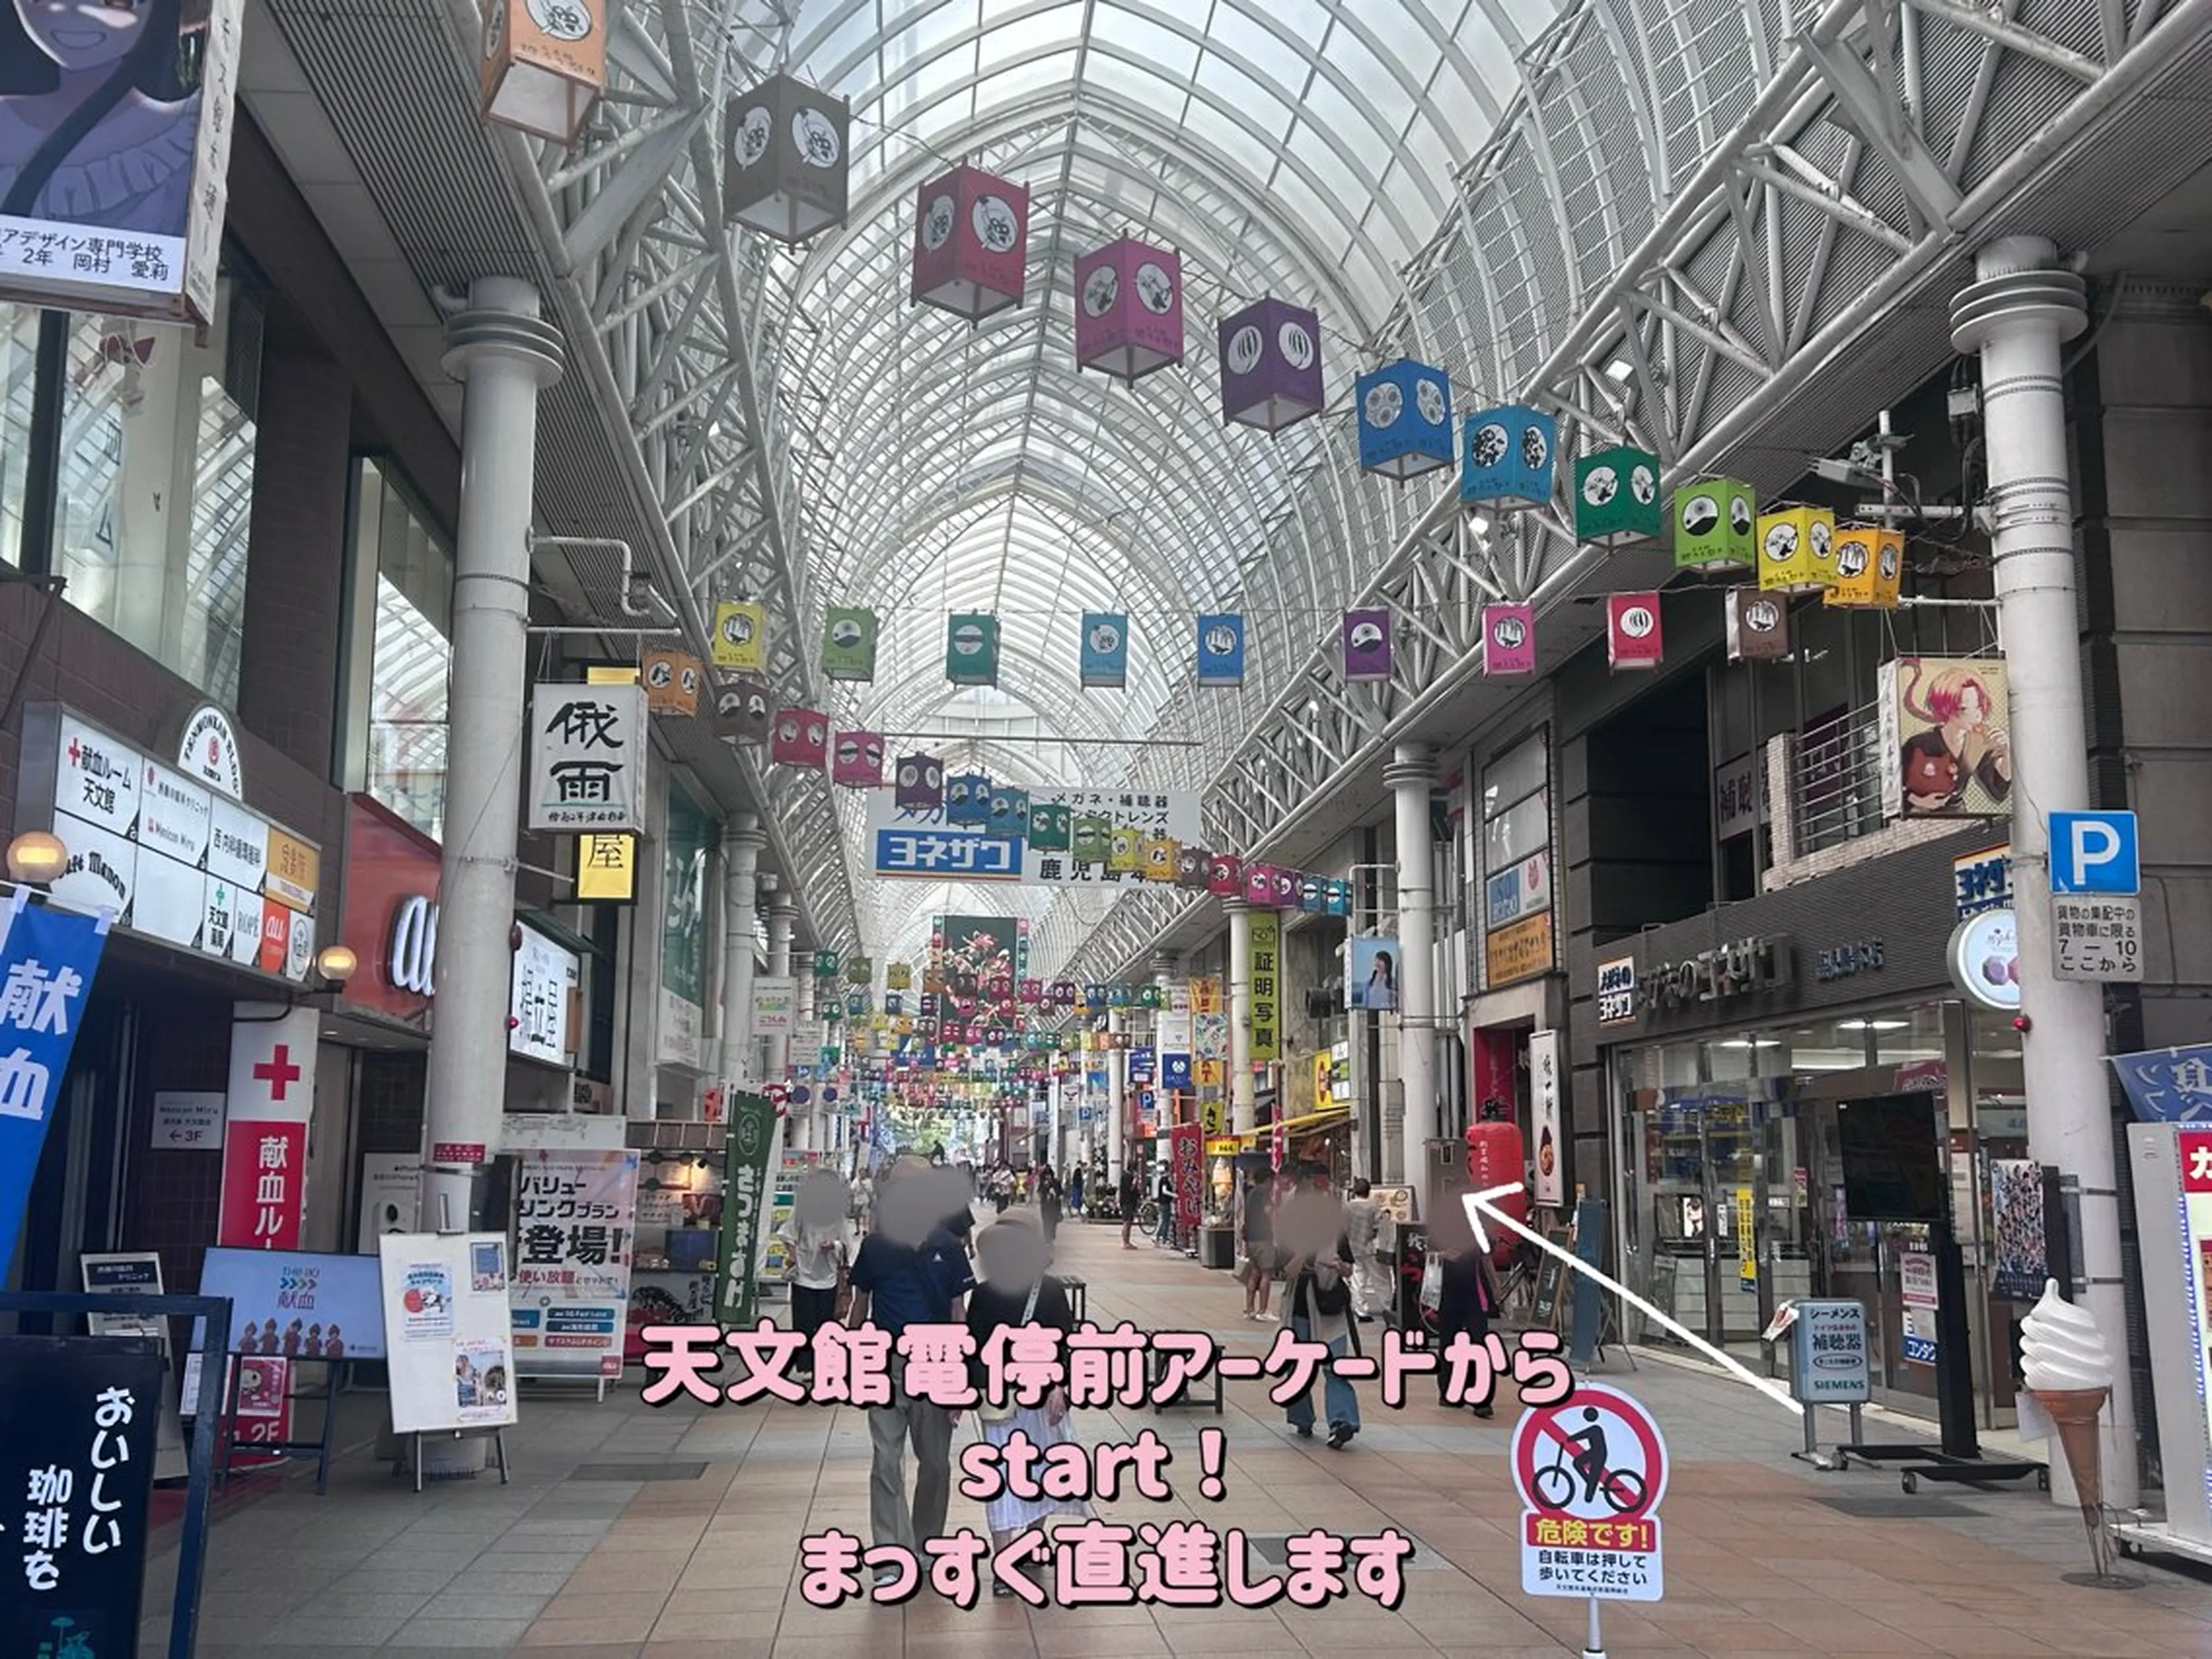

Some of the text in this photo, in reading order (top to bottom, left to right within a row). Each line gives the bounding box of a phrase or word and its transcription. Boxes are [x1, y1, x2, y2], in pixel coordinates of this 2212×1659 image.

[0, 228, 163, 263] アデザイン専門学校
[21, 248, 54, 266] 2年
[73, 252, 112, 273] 岡村
[81, 745, 132, 791] 献血ルーム
[82, 777, 115, 815] 天文館
[888, 836, 1013, 870] ヨネザワ
[2071, 820, 2121, 885] P
[2057, 905, 2135, 921] 貨物の集配中の
[2058, 923, 2135, 938] 貨物車に限る
[2058, 938, 2069, 954] 7
[2115, 940, 2137, 956] 10
[2060, 956, 2137, 972] ここから
[1254, 952, 1274, 1049] 証明写真
[0, 959, 83, 1121] 献血
[184, 1130, 203, 1142] 3F
[519, 1176, 587, 1195] バリュー
[517, 1224, 624, 1266] 登場!
[1810, 1308, 1861, 1319] シーメンス
[1812, 1332, 1862, 1351] 補聴器
[1814, 1380, 1865, 1391] SIEMENS
[82, 1385, 136, 1554] おいしい
[23, 1464, 72, 1590] 珈琲を
[1535, 1518, 1649, 1548] 危険です!
[1539, 1550, 1647, 1569] 自転車は押して
[1539, 1566, 1647, 1585] 歩いてください
